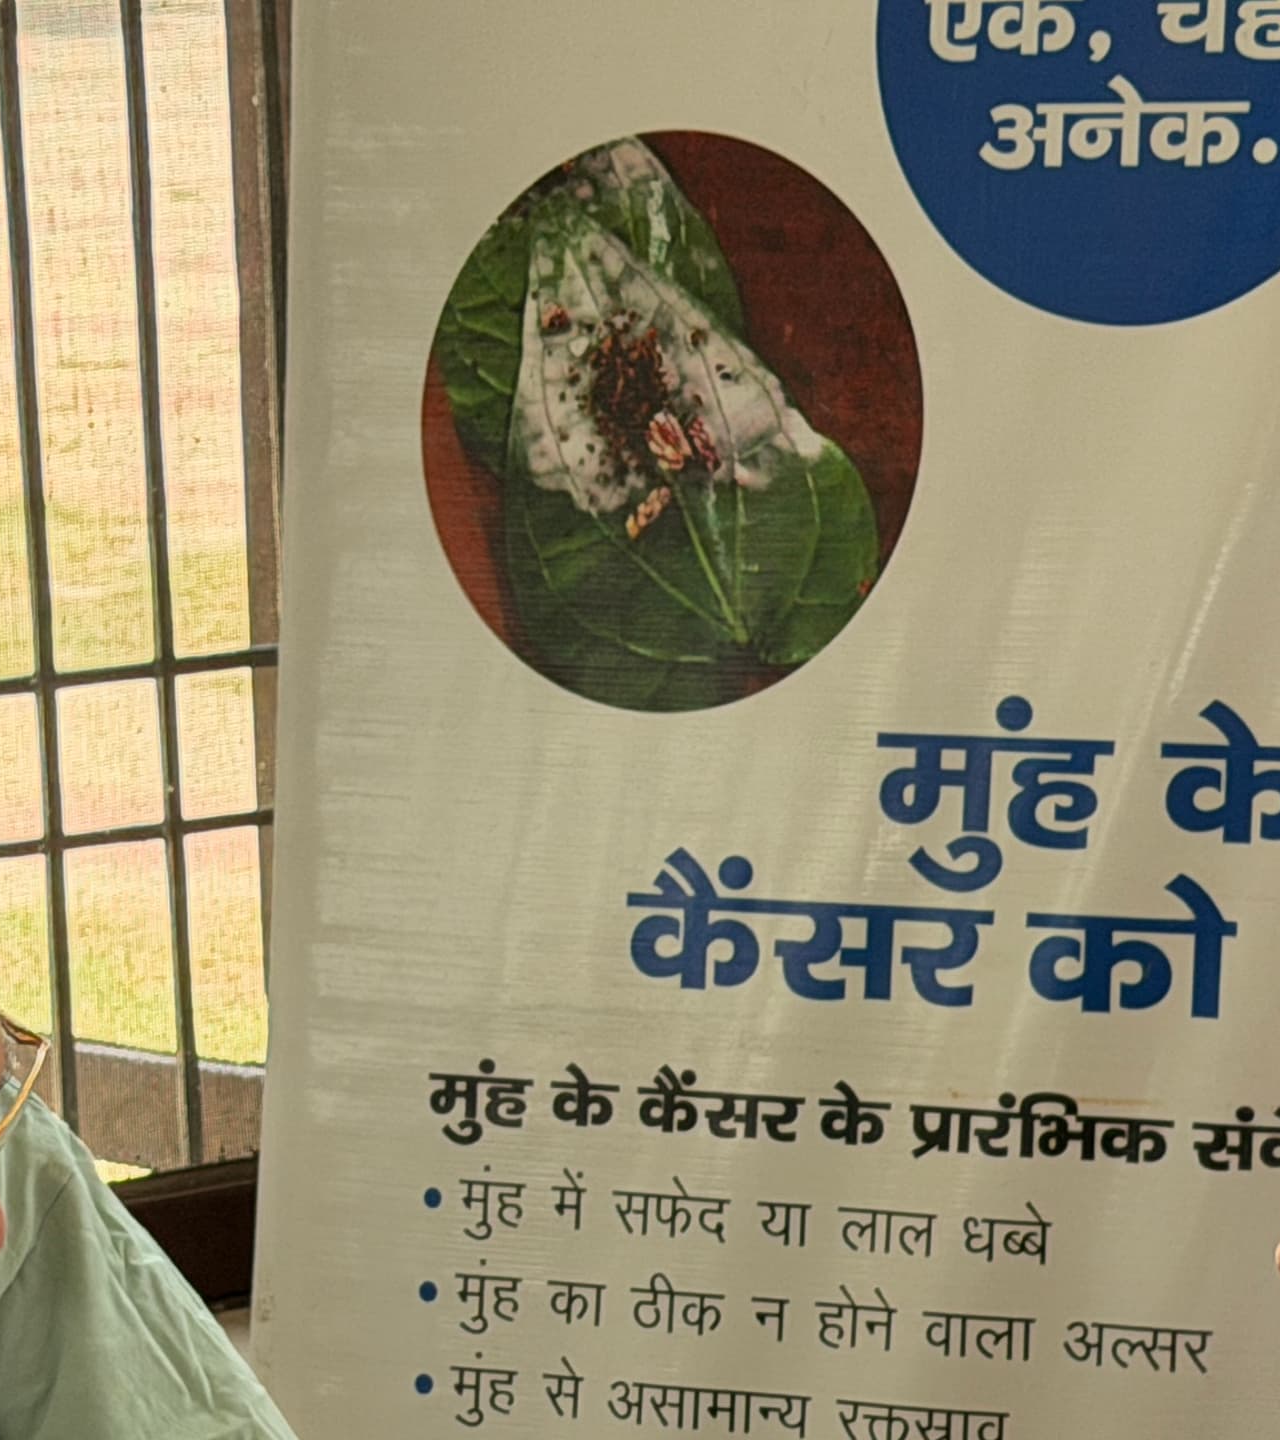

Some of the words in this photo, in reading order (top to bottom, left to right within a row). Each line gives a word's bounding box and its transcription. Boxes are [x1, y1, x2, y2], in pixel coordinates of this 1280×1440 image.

[979, 75, 1279, 170] अनेक.
[877, 695, 1117, 892] मुंह
[626, 847, 994, 1008] कैंसर
[1026, 873, 1238, 1019] को
[429, 1058, 534, 1145] मुंह
[550, 1063, 620, 1127] के
[637, 1064, 806, 1142] कैंसर
[818, 1080, 891, 1145] के
[910, 1092, 1175, 1164] प्रारंभिक
[458, 1165, 527, 1241] मुंह
[552, 1168, 587, 1230] में
[613, 1176, 731, 1244] सफेद
[757, 1201, 812, 1248] या
[838, 1207, 937, 1258] लाल
[964, 1202, 1052, 1266] धब्बे
[454, 1259, 523, 1335] मुंह
[548, 1280, 606, 1327] का
[630, 1273, 725, 1337] ठीक
[751, 1297, 790, 1343] न
[815, 1285, 897, 1352] होने
[923, 1312, 1036, 1362] वाला
[1064, 1322, 1213, 1374] अल्सर
[449, 1352, 519, 1428] मुंह
[543, 1357, 585, 1419] से
[608, 1381, 811, 1440] असामान्य
